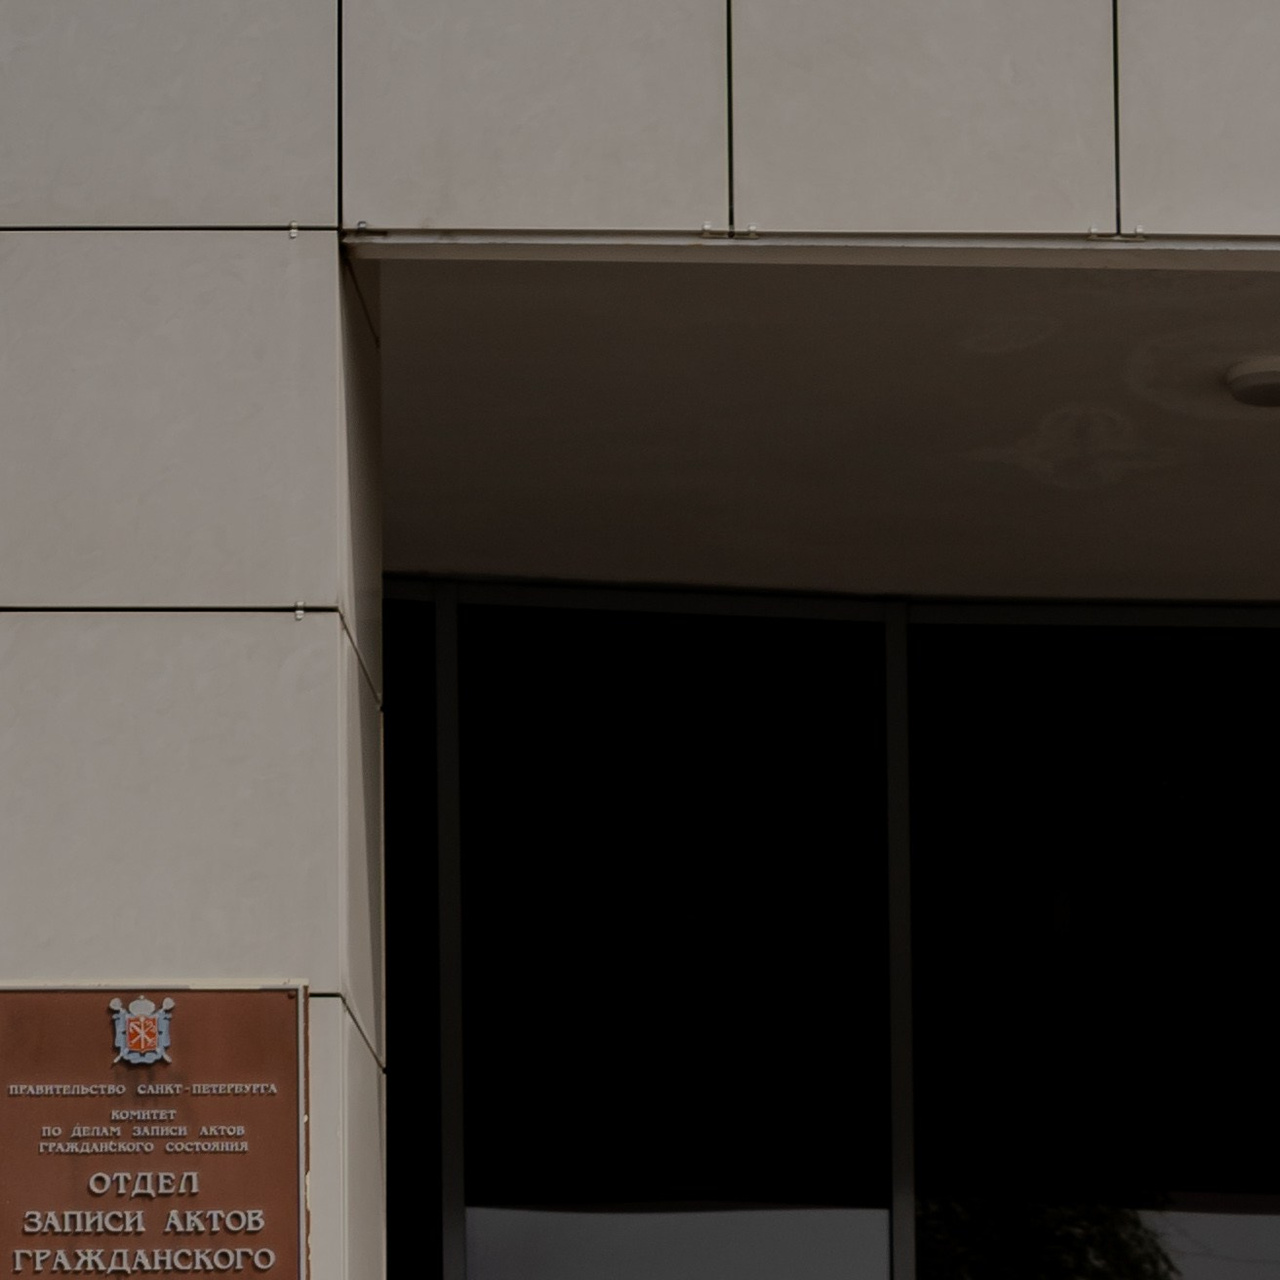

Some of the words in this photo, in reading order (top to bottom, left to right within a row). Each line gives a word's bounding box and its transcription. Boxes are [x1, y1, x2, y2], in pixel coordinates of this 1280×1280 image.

[8, 1083, 127, 1096] ПРАВИТЕЛЬСТВО
[110, 1108, 178, 1121] КОМИТЕТ
[41, 1126, 63, 1138] ПО
[70, 1125, 122, 1139] ДЕЛАМ
[132, 1125, 189, 1137] ЗАПИСИ
[199, 1124, 246, 1136] АКТОВ
[38, 1141, 155, 1155] ГРАЖДАНСКОГО
[165, 1141, 250, 1153] СОСТОЯНИЯ
[87, 1171, 201, 1198] ОТДЕЛ
[23, 1210, 146, 1233] ЗАПИСИ
[163, 1208, 266, 1232] АКТОВ
[12, 1247, 277, 1275] ГРАЖДАНСКОГО
